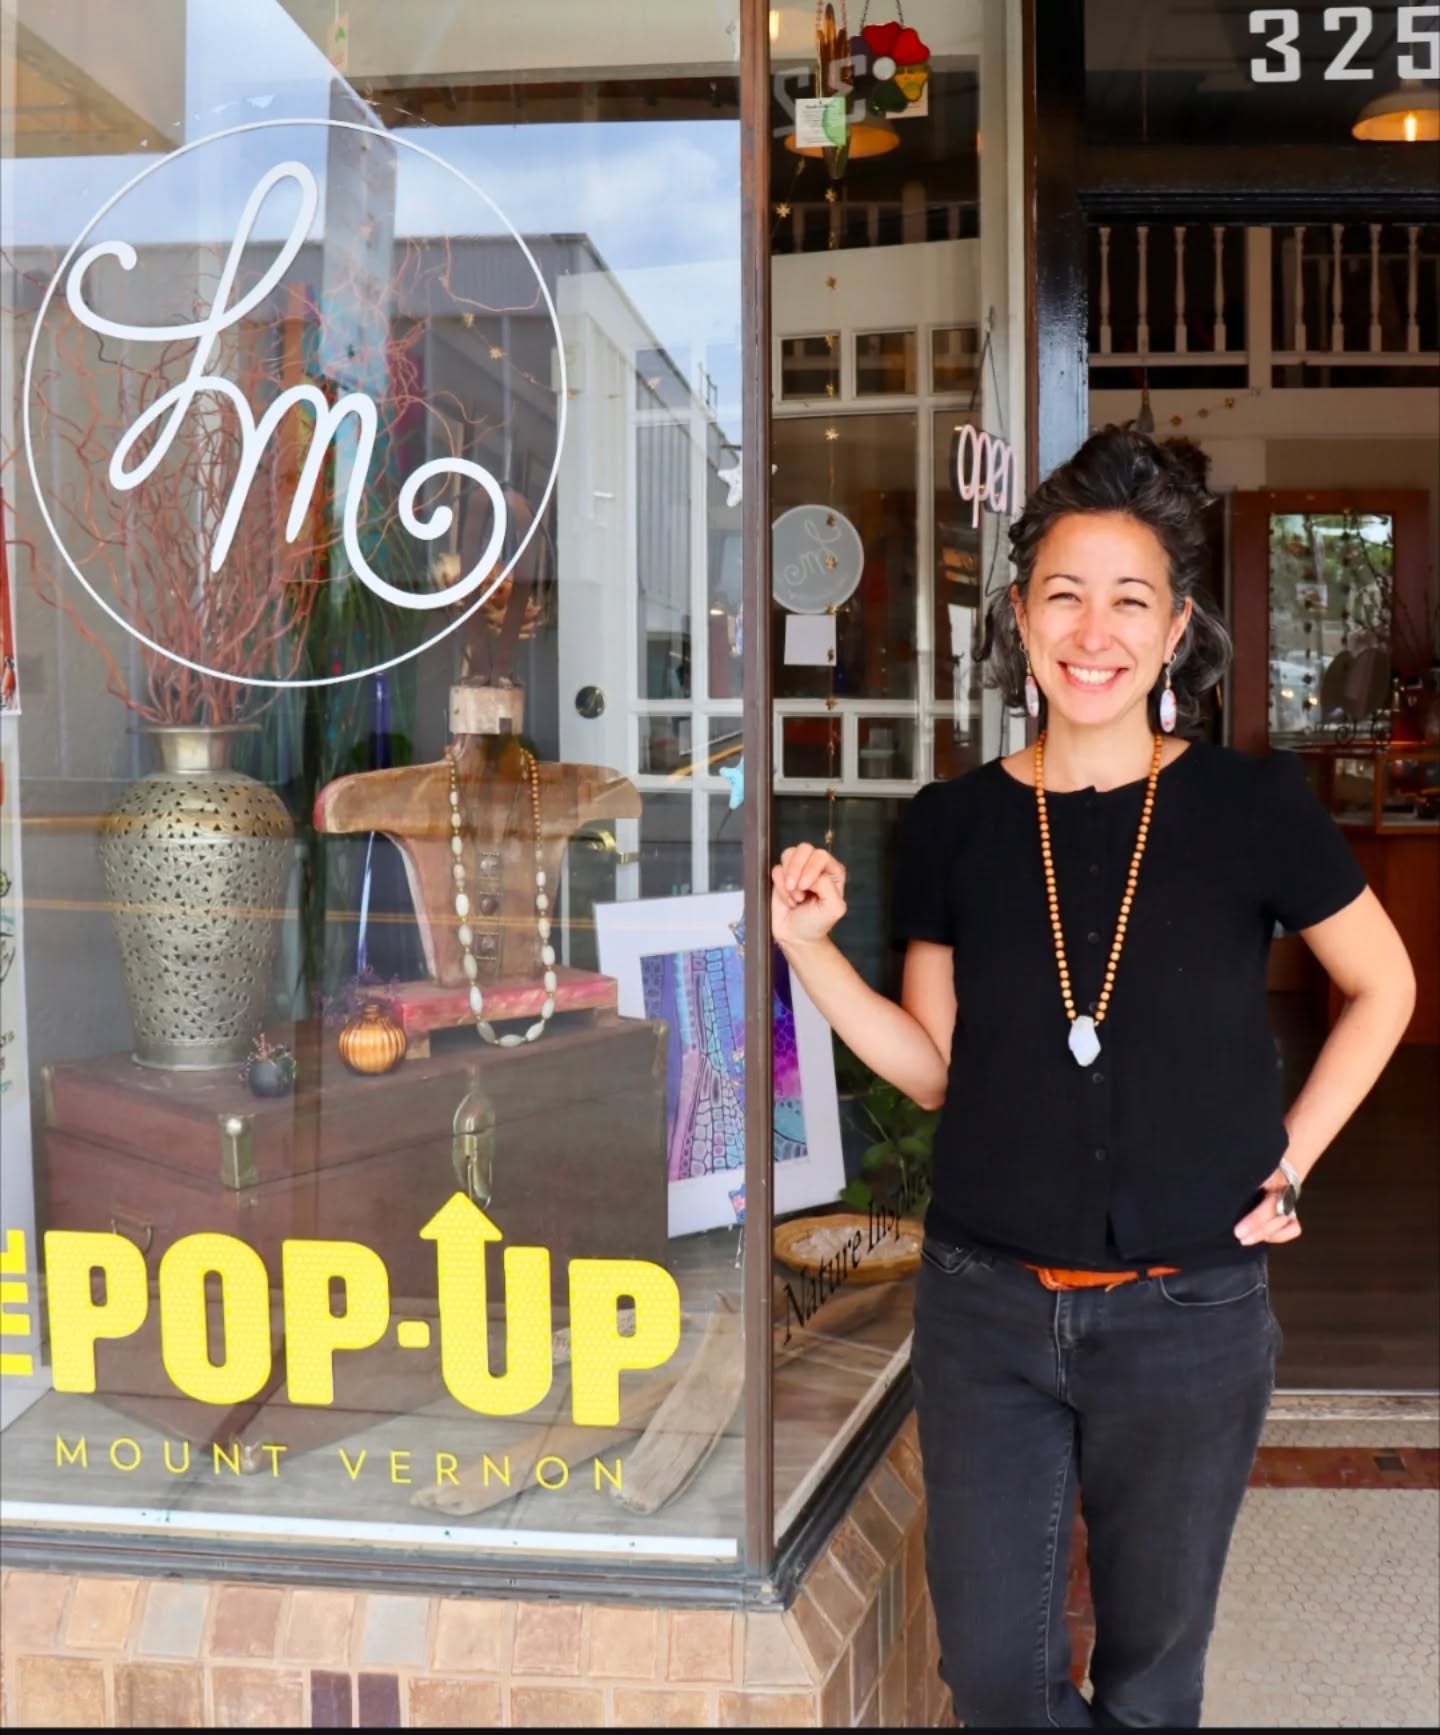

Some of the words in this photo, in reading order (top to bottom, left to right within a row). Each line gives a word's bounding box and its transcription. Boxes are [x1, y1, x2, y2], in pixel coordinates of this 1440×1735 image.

[1249, 5, 1440, 82] 325
[44, 1192, 681, 1426] POP-UP
[783, 1228, 862, 1346] Nature
[56, 1435, 288, 1478] MOUNT
[339, 1448, 624, 1491] VERNON
